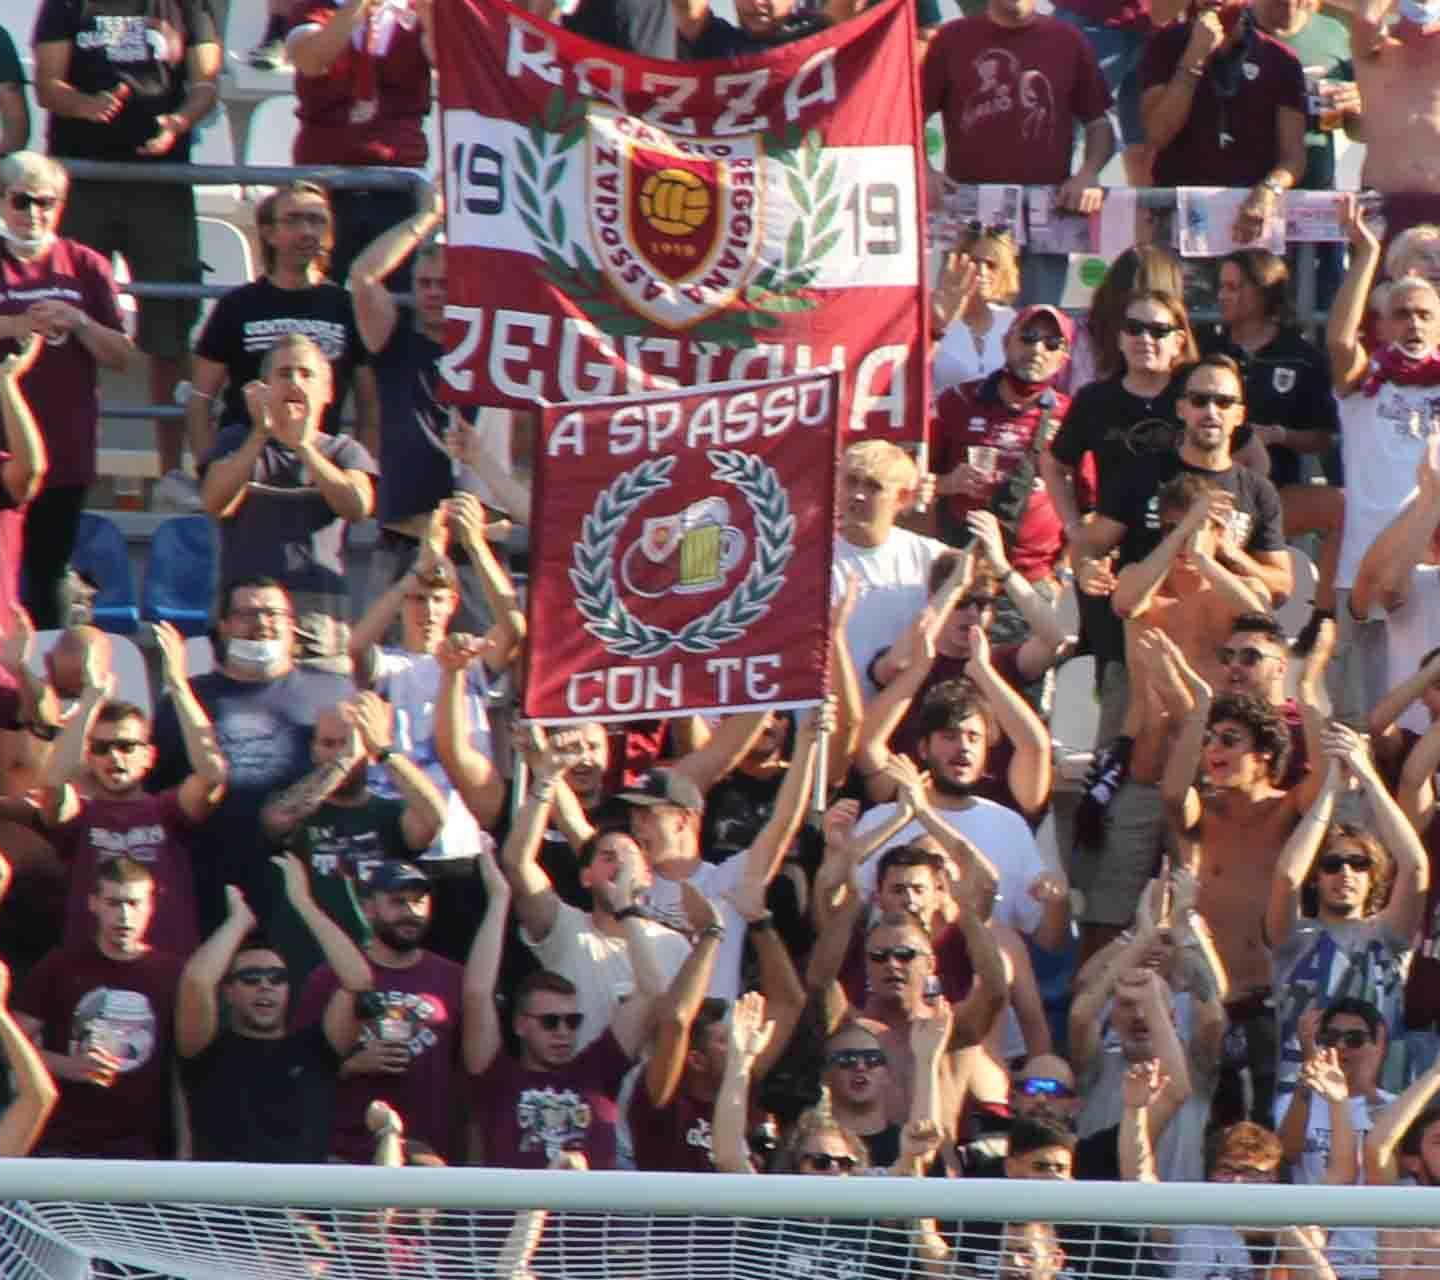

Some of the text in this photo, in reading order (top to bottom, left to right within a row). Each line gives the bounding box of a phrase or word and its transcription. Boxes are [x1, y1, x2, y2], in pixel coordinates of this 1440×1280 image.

[507, 17, 838, 136] RAZZA
[452, 142, 504, 216] 19
[682, 157, 754, 306] REGGIANA
[847, 182, 902, 257] 19
[548, 382, 830, 458] A SPASSO
[567, 654, 781, 713] CON TE
